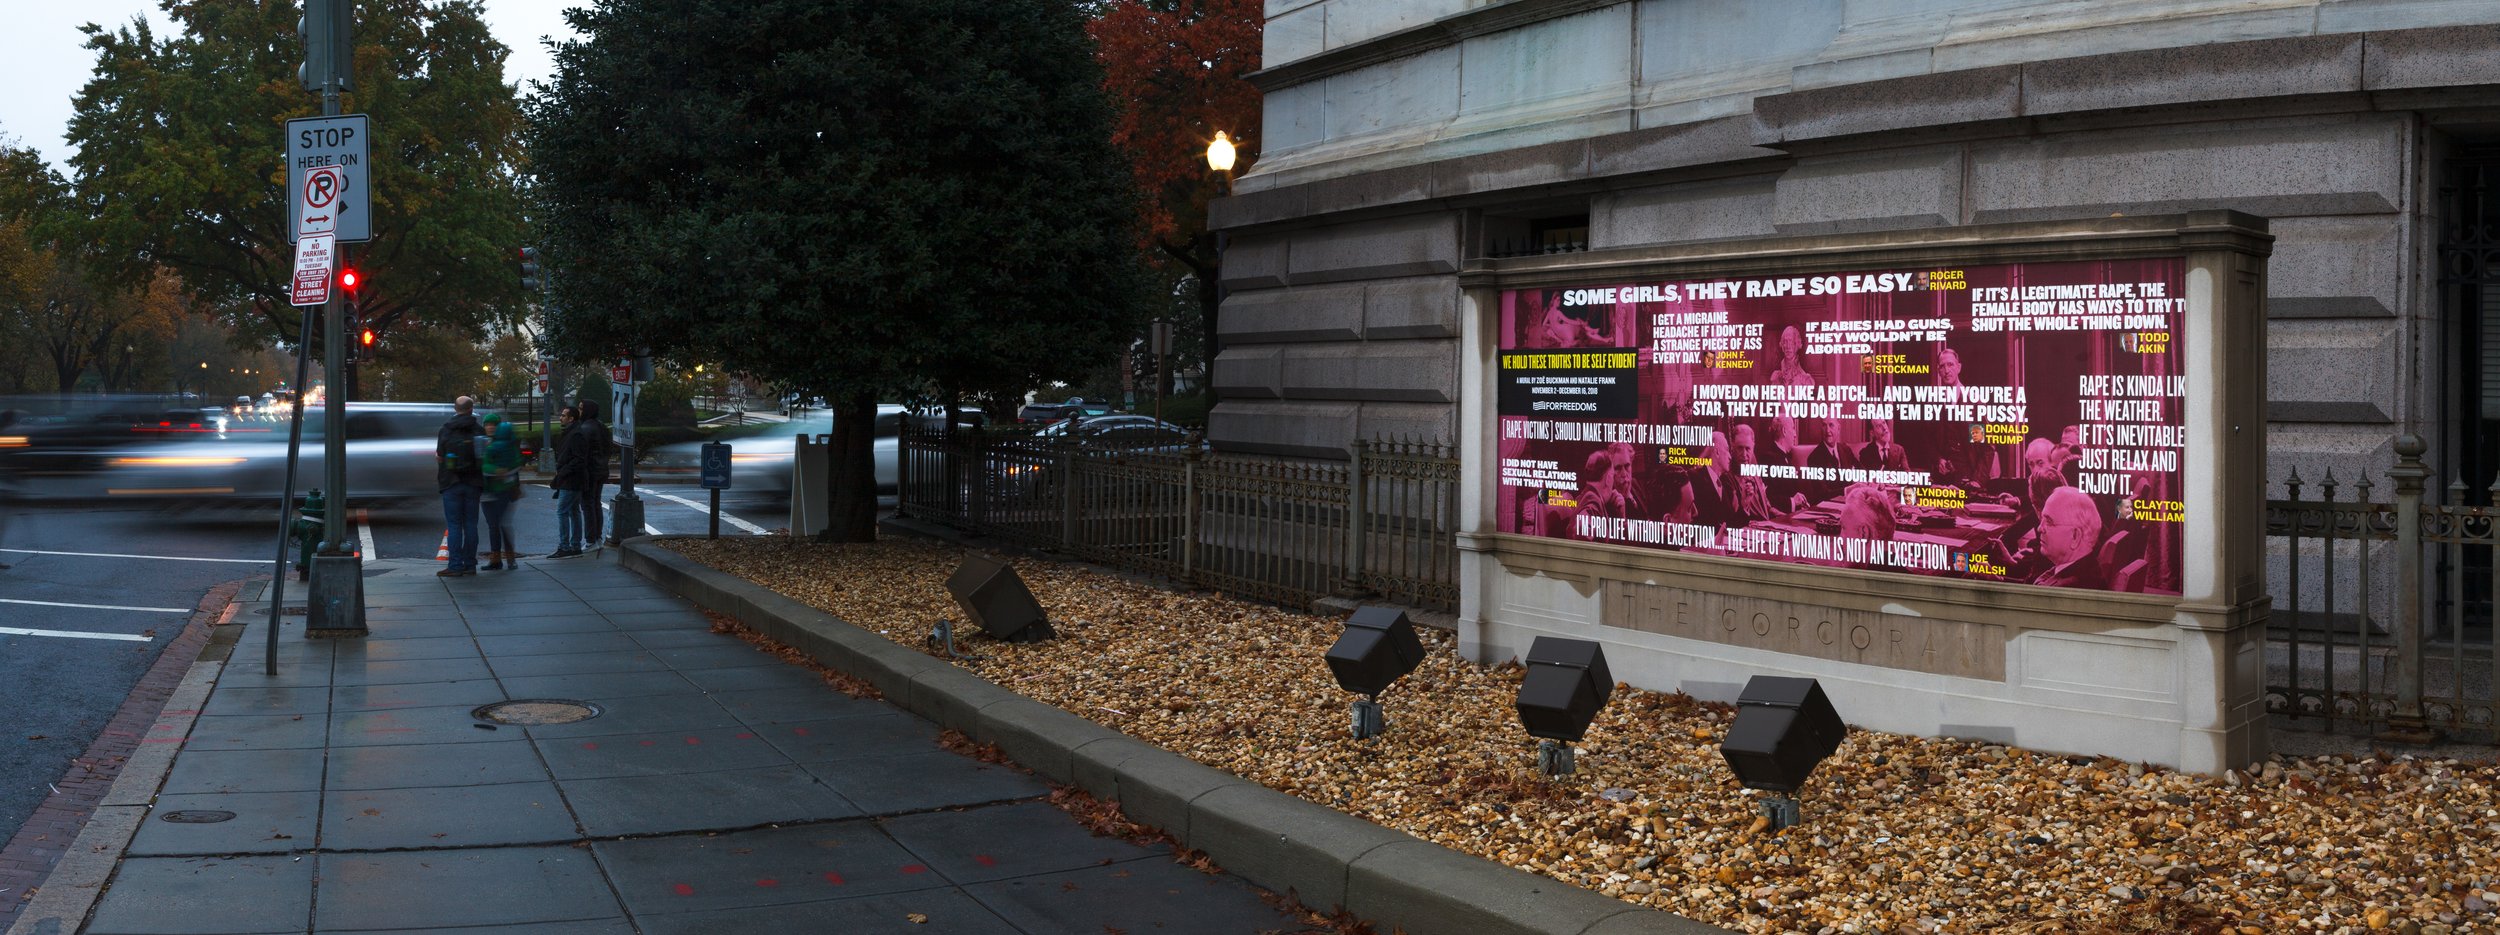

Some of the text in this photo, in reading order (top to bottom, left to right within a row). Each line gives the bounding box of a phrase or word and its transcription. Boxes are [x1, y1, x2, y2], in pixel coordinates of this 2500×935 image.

[301, 128, 354, 149] STOP
[298, 154, 357, 168] HERE ON
[303, 249, 327, 257] PARKING
[1930, 271, 1964, 280] ROGER
[1564, 273, 1913, 306] SOME GIRLS, RAPE SO EASY.
[1930, 281, 1966, 290] RIVARD
[297, 289, 324, 297] CLEANING
[2022, 284, 2136, 300] LEGITIMATE RAPE,
[1972, 298, 2186, 316] FEMALE BODY HAS WAYS TRY T
[1658, 312, 1728, 325] GET MIGRAINE
[1972, 315, 2168, 331] SHUT WHOLE THING DOWN.
[1653, 324, 1763, 338] HEADACHE DON'T GET
[1822, 319, 1954, 331] BABIES HAD GUNS,
[1845, 331, 1946, 342] WOULDN'T BE
[2138, 333, 2169, 342] TODD
[1660, 337, 1762, 351] STRANGE PIECE ASS
[1806, 344, 1873, 354] ABORTED.
[2138, 344, 2165, 354] AKIN
[1503, 353, 1636, 369] WE HOLD THESE TRUTHS BE SELF EVIDENT
[1653, 352, 1701, 364] EVERY DAY.
[1716, 351, 1745, 360] JOHN F.
[1876, 355, 1906, 363] STEVE
[1876, 365, 1929, 374] STOCKMAN
[2080, 375, 2109, 396] RAPE
[2113, 375, 2124, 396] IS
[2127, 375, 2163, 396] KINDA
[1700, 385, 2026, 403] MOVED ON HER LIKE A AND WHEN YOU'RE A
[1546, 402, 1596, 411] FORFREEDOMS
[1693, 401, 2028, 422] STAR, THEY LET YOU DO GRAB BY THE PUSSY.
[2080, 400, 2163, 421] THE WEATHER.
[1555, 422, 1580, 441] SHOULD
[1583, 423, 1601, 442] MAKE
[1604, 423, 1617, 443] THE
[1619, 424, 1636, 443] BEST
[1639, 424, 1648, 444] OF
[1656, 425, 1670, 445] BAD
[1672, 426, 1714, 446] SITUATION.
[1986, 424, 2028, 434] DONALD
[1986, 434, 2023, 444] TRUMP
[2079, 424, 2184, 447] IF IT'S INEVITABLE
[1669, 448, 1686, 456] RICK
[1507, 459, 1558, 470] DID NOT HAVE
[1669, 457, 1712, 466] SANTORUM
[2079, 449, 2176, 472] JUST RELAX AND
[1503, 468, 1576, 480] SEXUAL RELATIONS
[1741, 464, 1931, 486] MOVE THIS IS YOUR PRESIDENT.
[1503, 477, 1578, 491] WITH THAT WOMAN.
[2079, 473, 2133, 495] ENJOY IT.
[1549, 490, 1563, 498] BILL
[1916, 488, 1968, 498] LYNDON B.
[1548, 498, 1577, 507] CLINTON
[1916, 498, 1964, 509] JOHNSON
[2134, 500, 2185, 511] CLAYTON
[1577, 515, 1951, 570] I'M PRO LIFE WITHOUT THE LIFE OF WOMAN IS NOT AN EXCEPTION.
[1969, 554, 1988, 563] JOE
[1969, 564, 2005, 575] WALSH
[1622, 592, 1980, 666] THE CORCORAN
